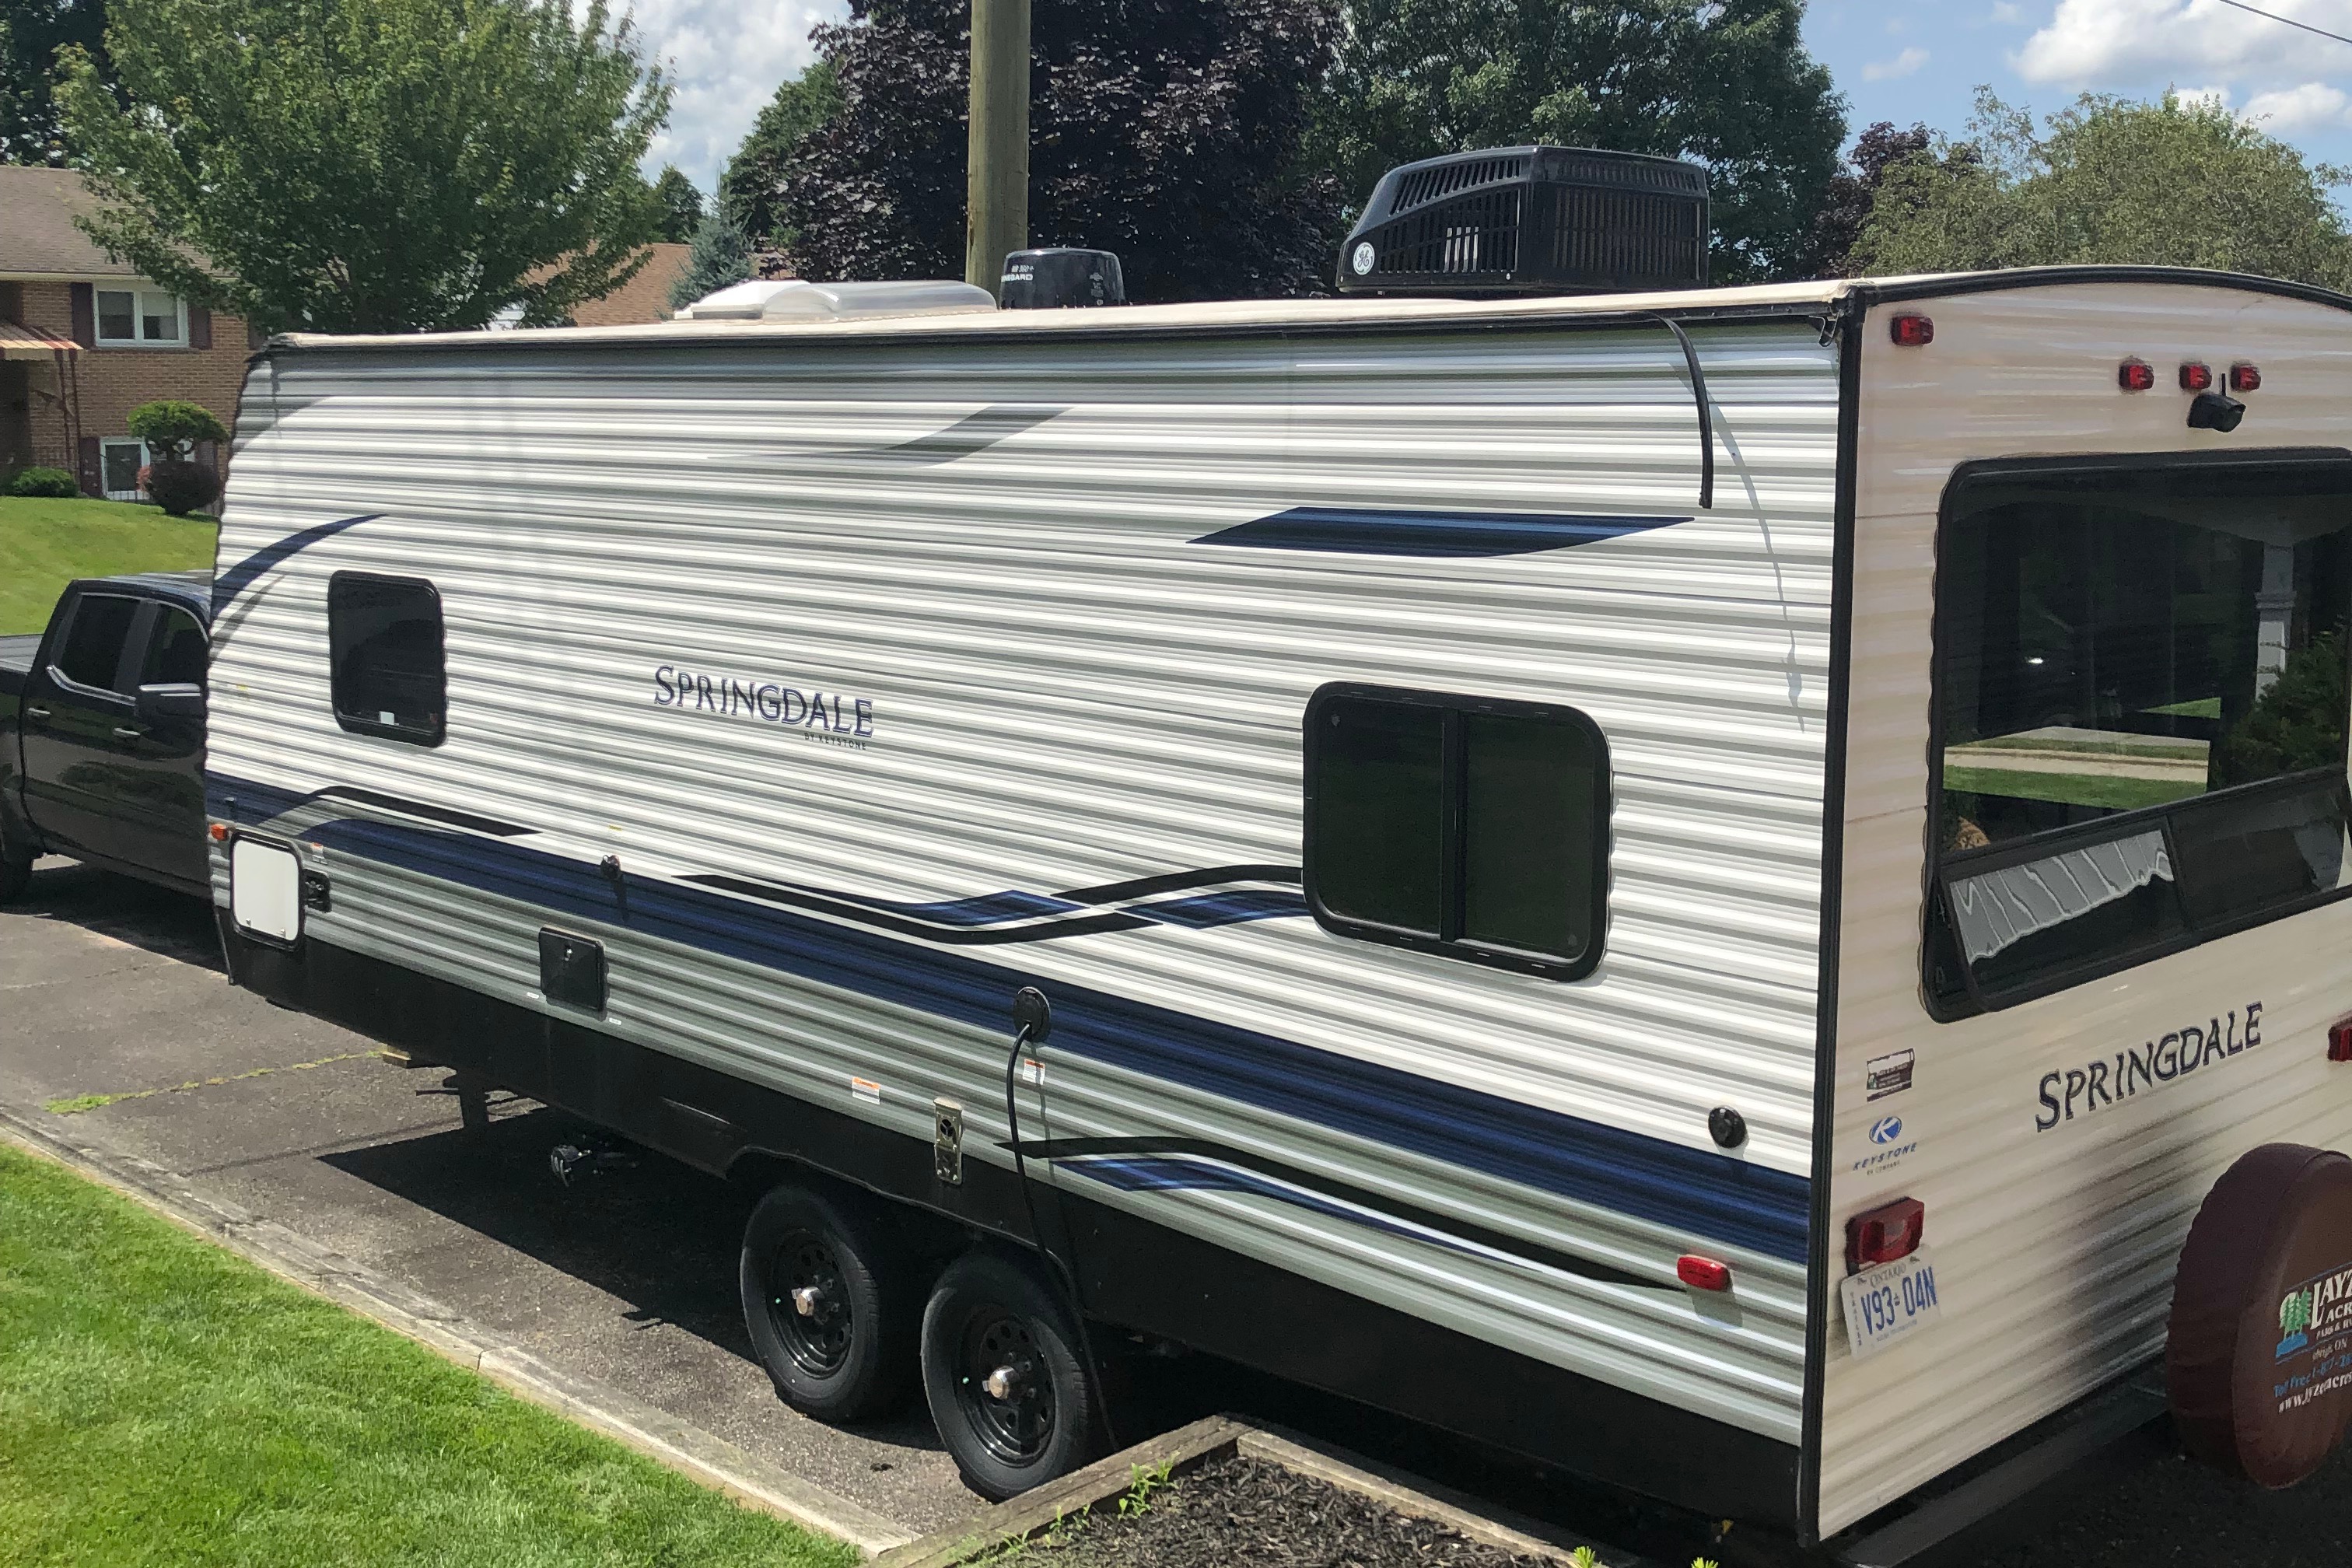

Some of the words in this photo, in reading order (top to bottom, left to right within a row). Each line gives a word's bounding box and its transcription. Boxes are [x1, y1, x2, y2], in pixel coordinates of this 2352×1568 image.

[653, 664, 875, 738] SPRINGDALE
[803, 732, 814, 740] BY
[818, 734, 866, 751] KEYSTONE
[2035, 999, 2263, 1133] SPRINGDALE
[1853, 1142, 1917, 1171] KEYSTONE
[1870, 1262, 1906, 1288] ONTARIO
